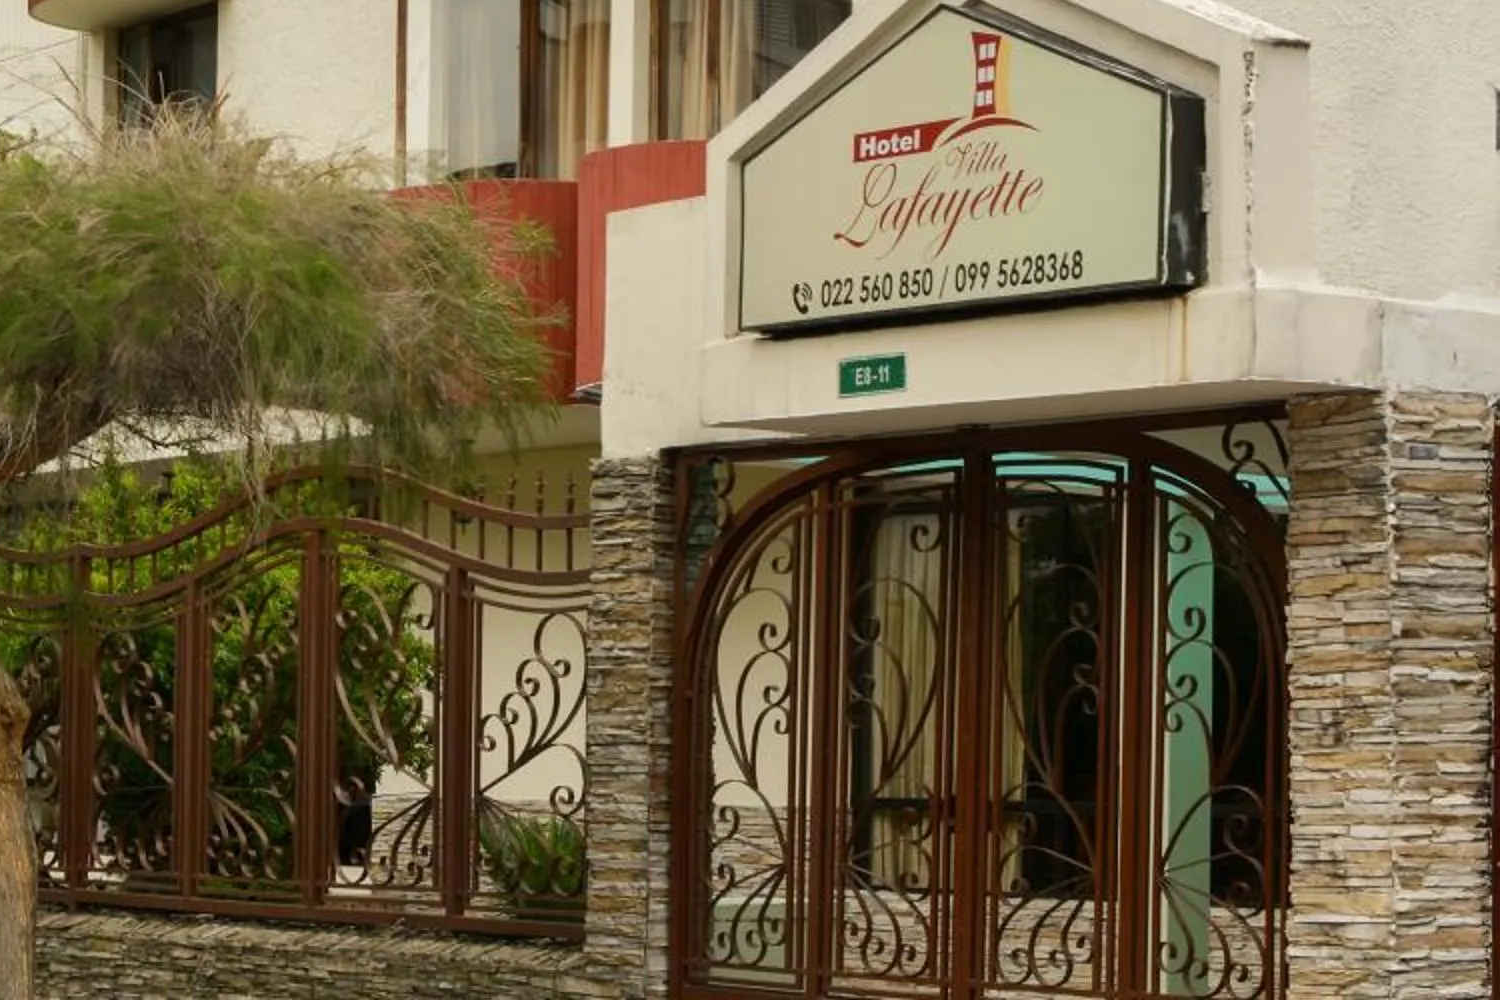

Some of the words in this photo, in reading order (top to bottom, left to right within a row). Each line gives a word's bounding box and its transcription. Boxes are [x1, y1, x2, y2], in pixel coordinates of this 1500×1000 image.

[859, 130, 921, 159] Hotel
[945, 140, 1008, 180] Villa
[833, 162, 1044, 260] Lafayette
[820, 279, 853, 308] 022
[859, 273, 893, 304] 560
[899, 268, 933, 299] 850
[938, 265, 950, 299] /
[954, 261, 990, 294] 099
[997, 249, 1084, 287] 5628368
[854, 364, 890, 386] E8-11
